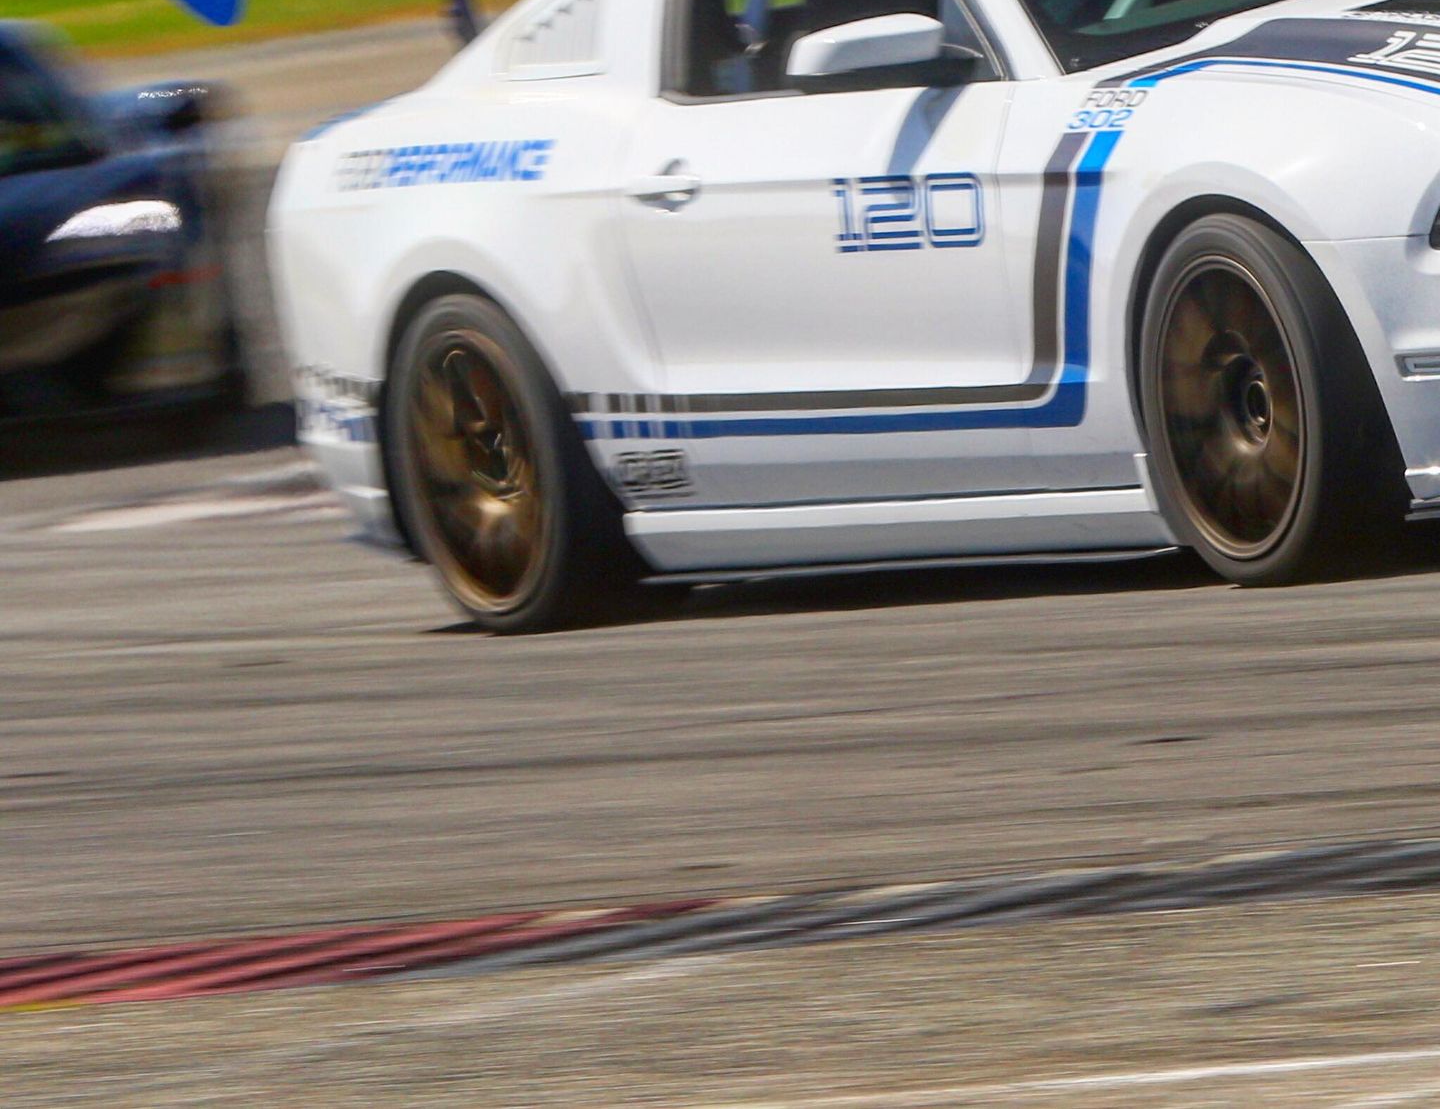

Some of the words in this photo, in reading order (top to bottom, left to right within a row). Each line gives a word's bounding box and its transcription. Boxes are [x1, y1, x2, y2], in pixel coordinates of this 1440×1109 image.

[1081, 90, 1148, 108] FORD
[1067, 109, 1133, 129] 302
[832, 171, 986, 253] 120
